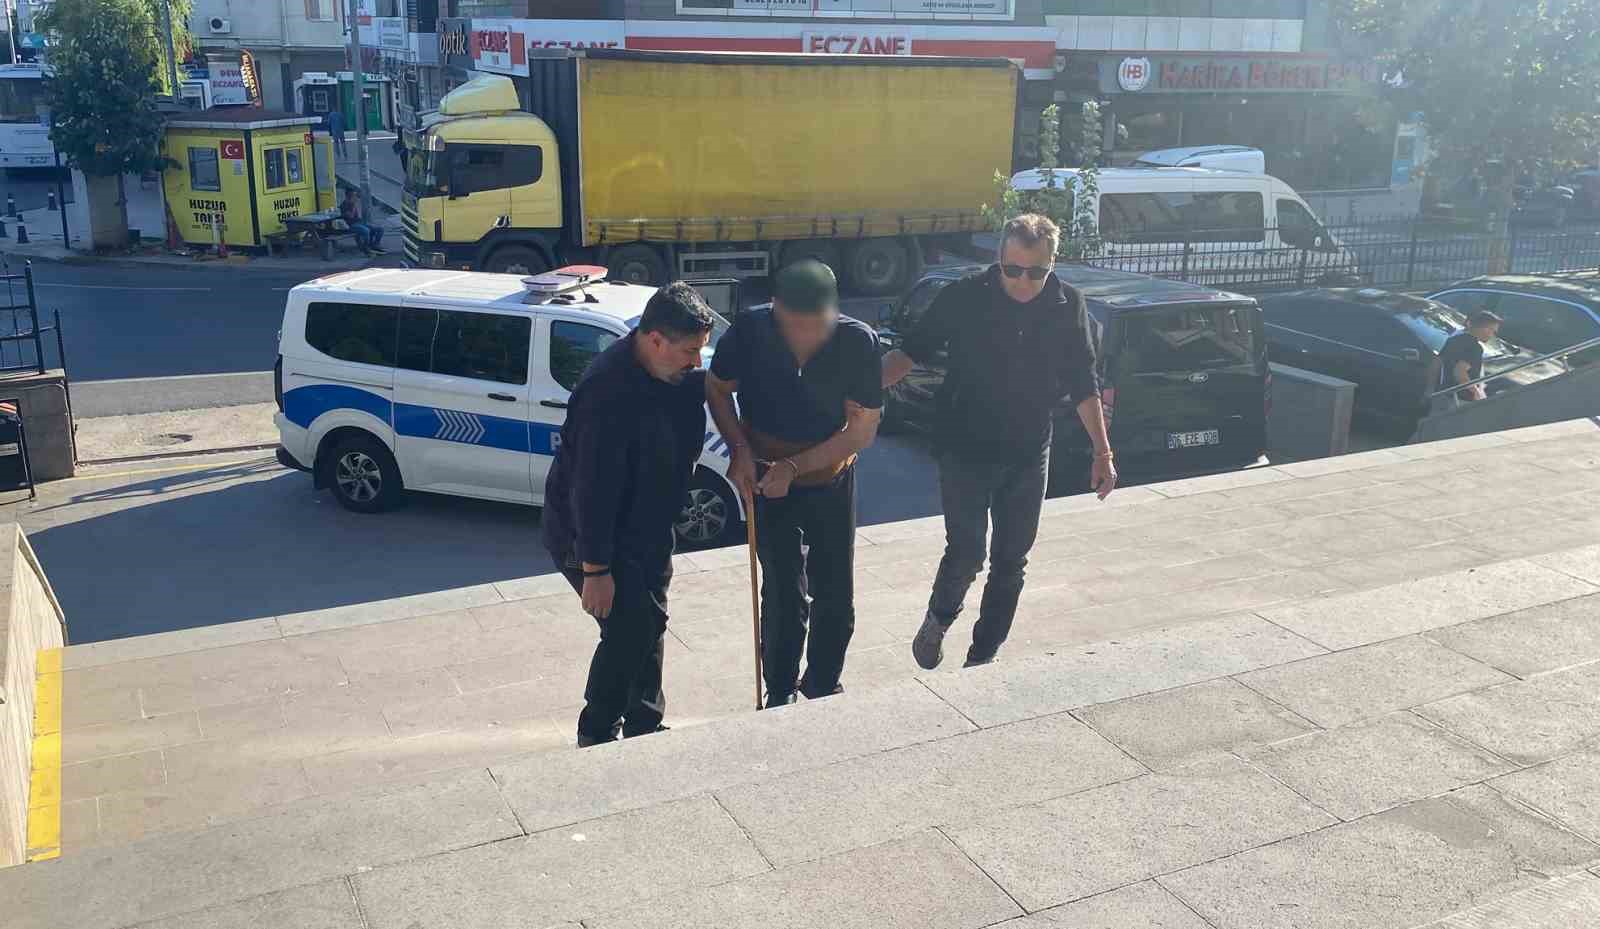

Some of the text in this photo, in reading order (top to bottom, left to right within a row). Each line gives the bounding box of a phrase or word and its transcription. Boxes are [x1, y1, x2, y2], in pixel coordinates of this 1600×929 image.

[810, 36, 906, 55] ECZANE
[189, 199, 227, 211] HUZUR
[274, 197, 300, 210] HUZUR
